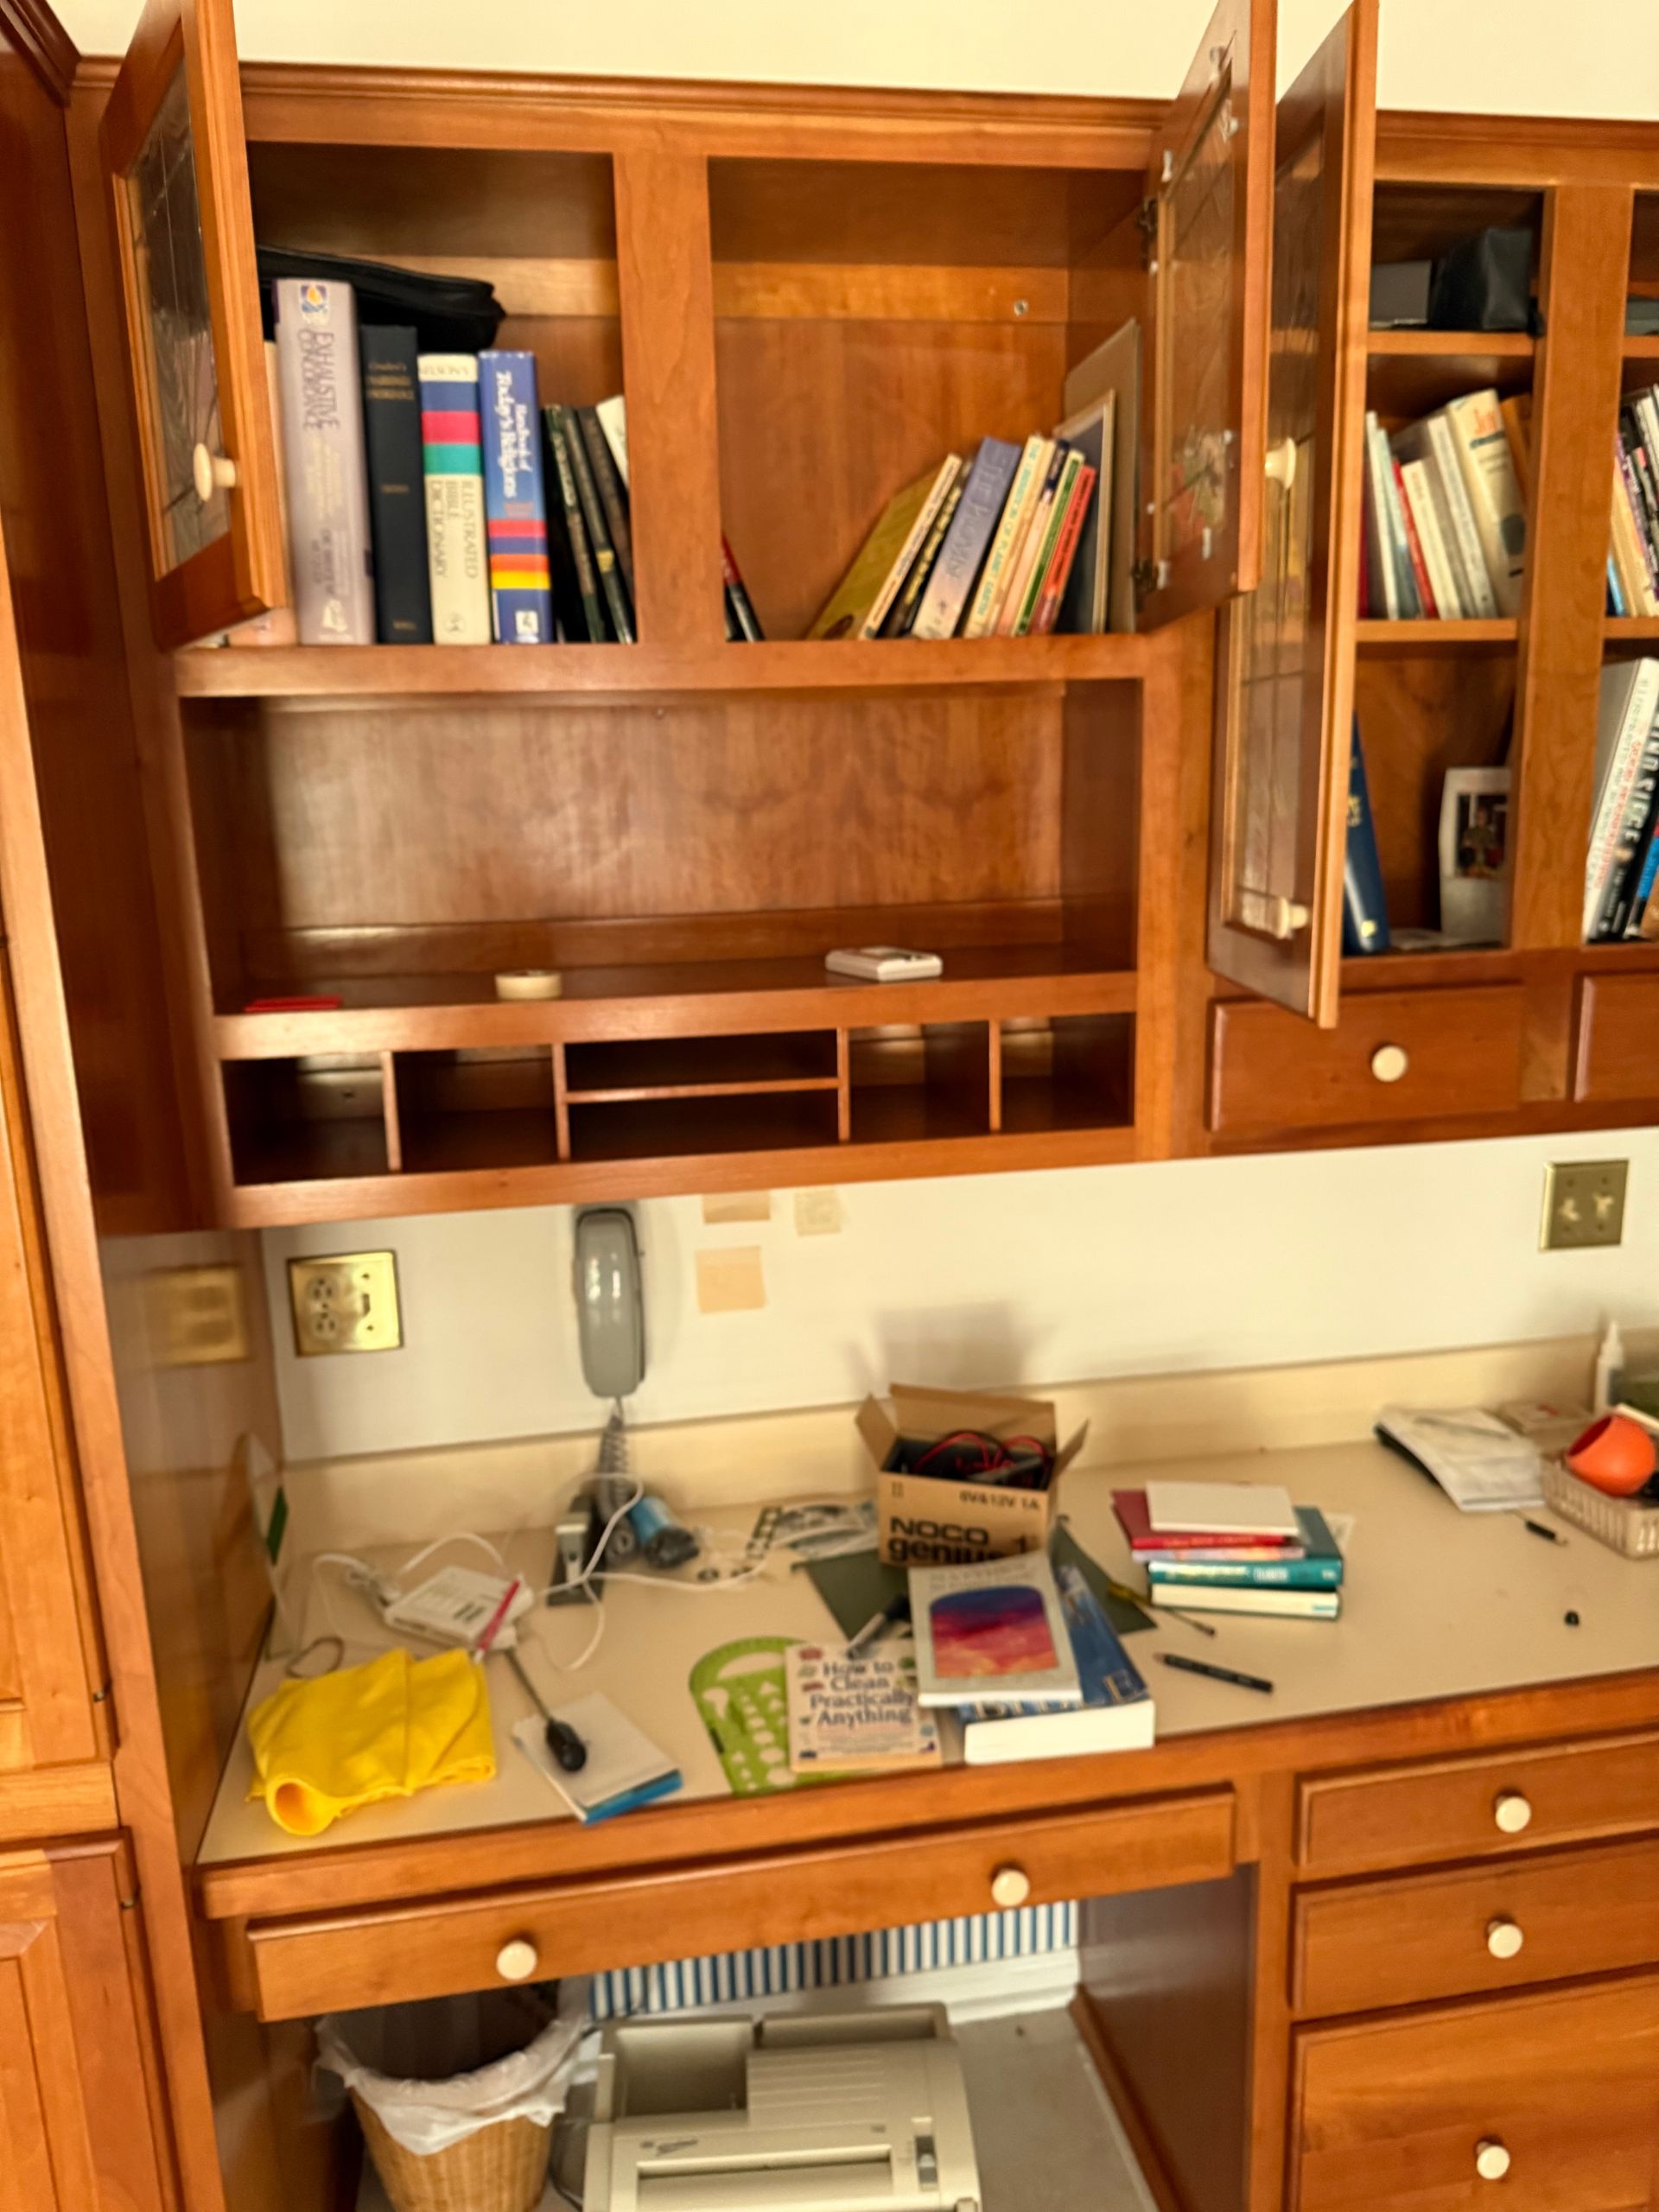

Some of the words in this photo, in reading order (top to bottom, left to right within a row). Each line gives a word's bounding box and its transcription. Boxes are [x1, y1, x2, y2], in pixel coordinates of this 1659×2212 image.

[296, 327, 322, 429] CONCORDANCE
[316, 331, 340, 430] EXHAUSTIVE
[494, 371, 515, 429] Today's
[498, 431, 518, 498] Religions
[446, 480, 461, 520] BIBLE
[429, 480, 448, 577] DICTIONARY
[461, 480, 479, 580] ILLUSTRATED
[889, 1516, 989, 1545] NOCO
[823, 1661, 866, 1675] How
[874, 1662, 894, 1674] to
[830, 1675, 890, 1691] Clean
[810, 1688, 913, 1708] Practically
[818, 1708, 912, 1729] Anything
